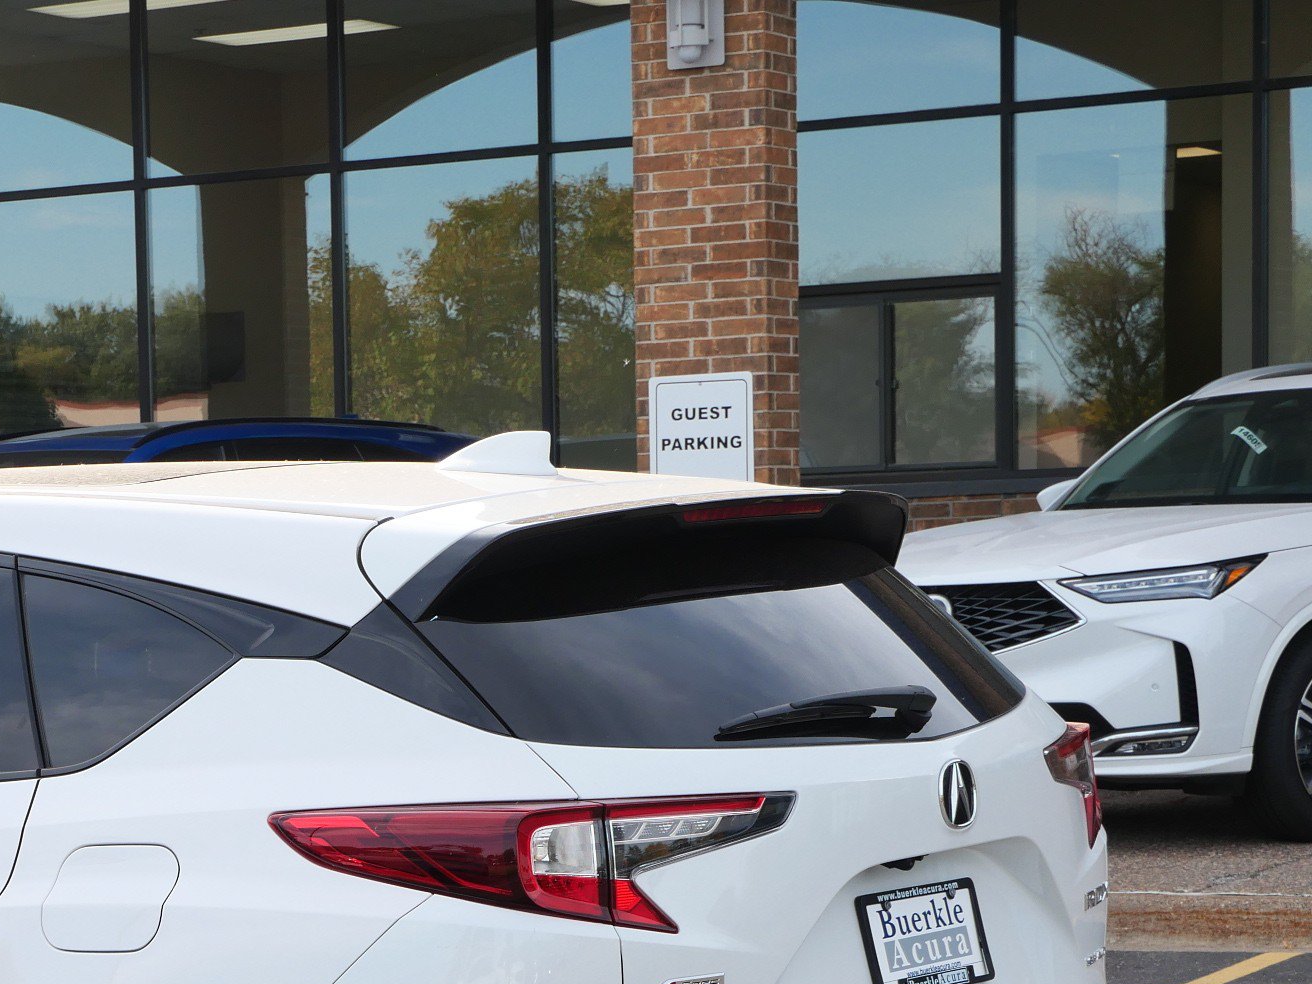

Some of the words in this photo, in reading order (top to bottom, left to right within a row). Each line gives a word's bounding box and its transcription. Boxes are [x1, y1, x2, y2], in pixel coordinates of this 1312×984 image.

[672, 407, 732, 421] GUEST
[661, 435, 743, 451] PARKING
[877, 882, 959, 902] www.buerkleacura.com
[876, 896, 965, 939] Buerkle
[892, 932, 970, 969] Acura
